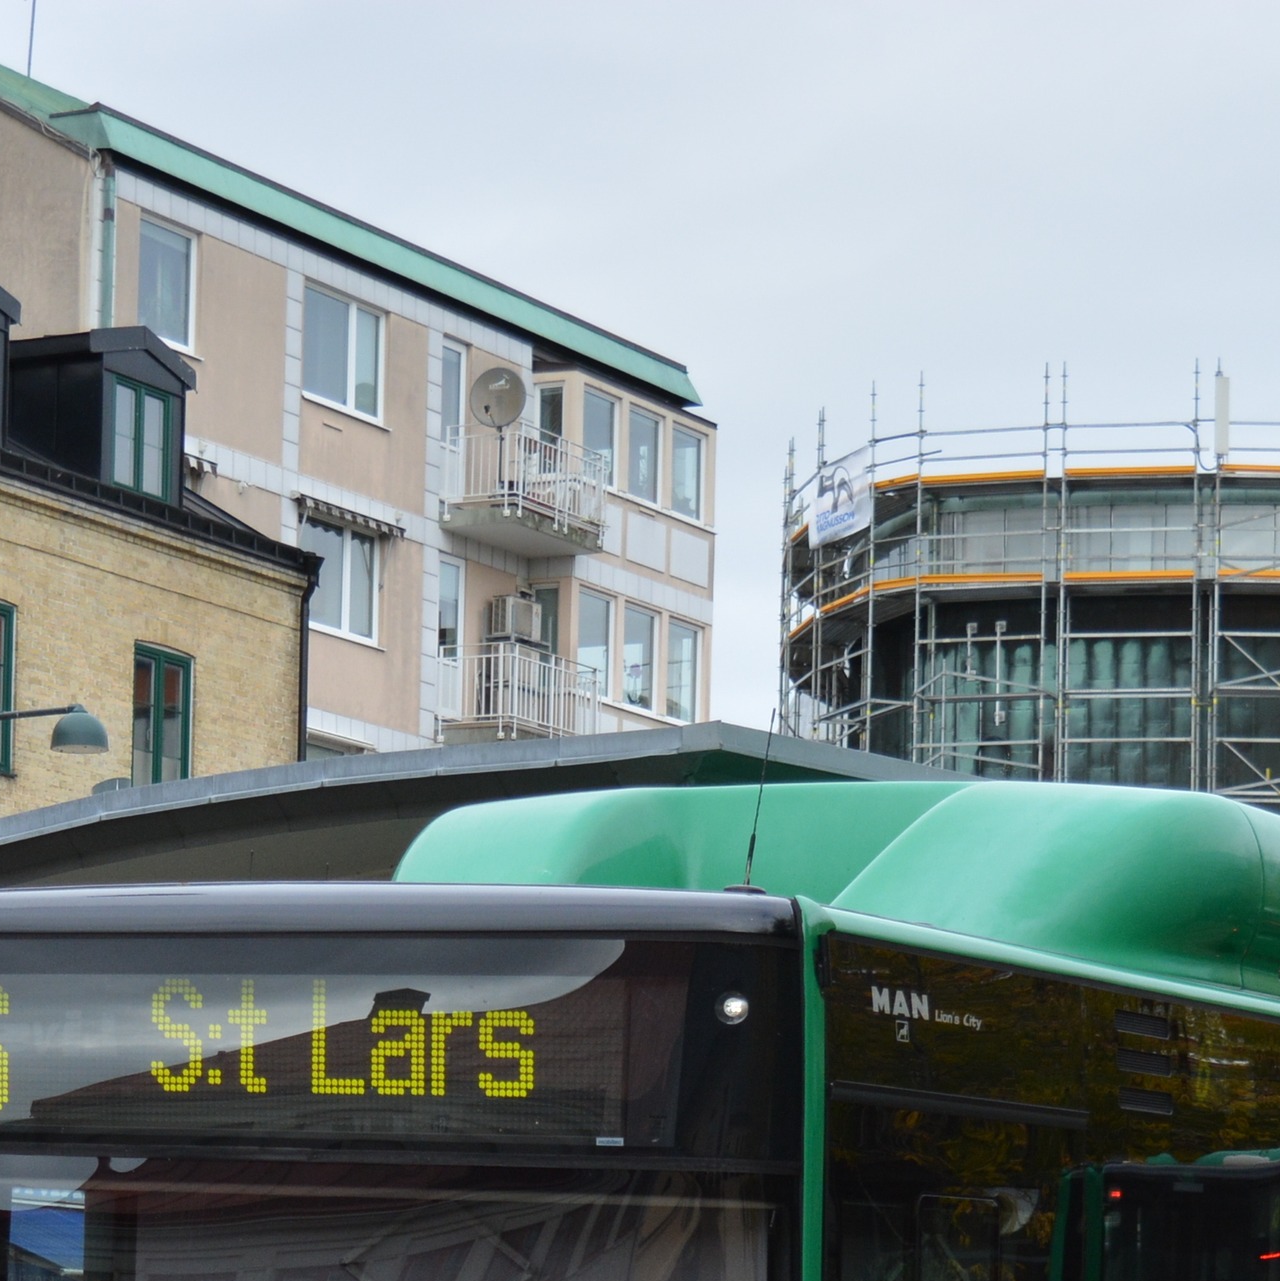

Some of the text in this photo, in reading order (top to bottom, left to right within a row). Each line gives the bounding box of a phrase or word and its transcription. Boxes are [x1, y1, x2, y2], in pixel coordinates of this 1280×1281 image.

[151, 977, 269, 1095] S:t
[311, 977, 536, 1100] Lars
[871, 985, 982, 1031] MAN Lion's City
